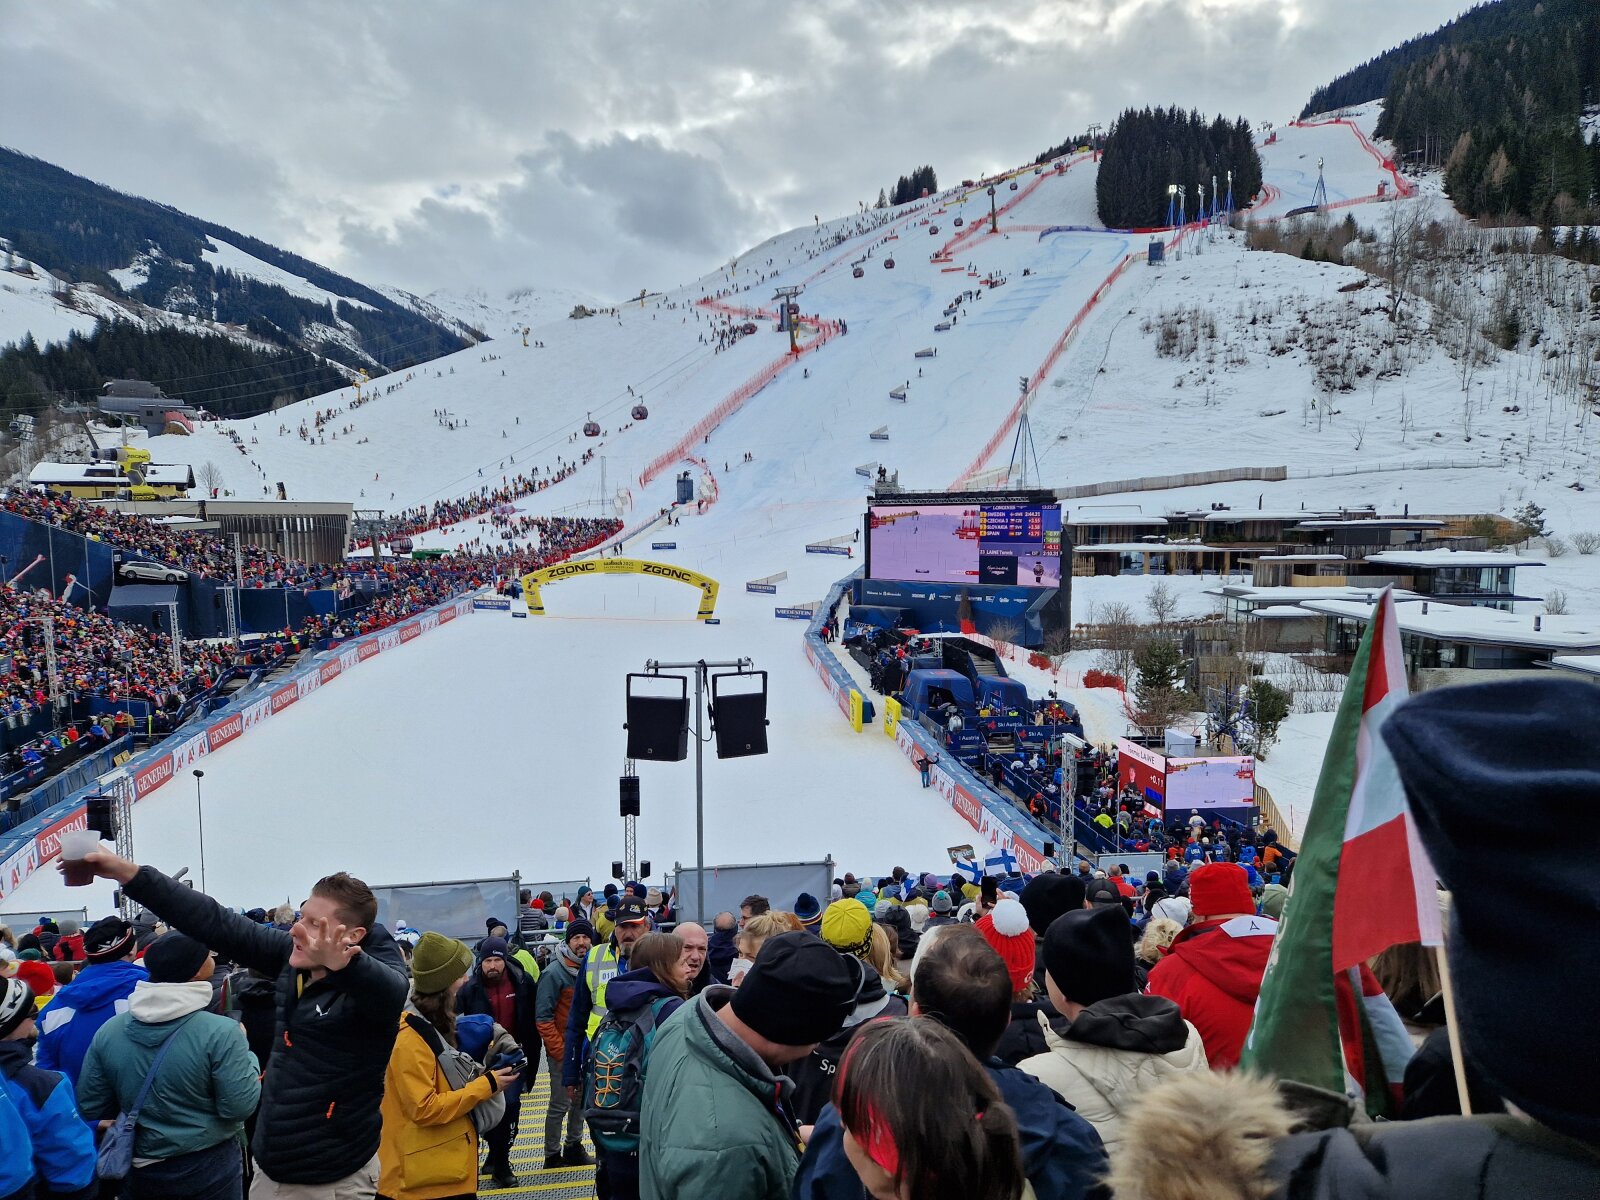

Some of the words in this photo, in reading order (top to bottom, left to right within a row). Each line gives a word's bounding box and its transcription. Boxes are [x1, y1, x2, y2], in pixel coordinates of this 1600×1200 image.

[549, 563, 596, 577] ZGONC
[643, 564, 692, 581] ZGONC
[321, 661, 341, 680] GENERALI
[272, 685, 299, 709] GENERALI
[209, 718, 242, 746] GENERALI
[176, 752, 184, 773] A1
[187, 744, 195, 765] A1
[198, 738, 206, 758] A1
[136, 758, 173, 794] GENERALI
[954, 791, 981, 825] GENERALI
[39, 811, 88, 858] GENERAL
[981, 818, 989, 834] A1
[990, 828, 999, 845] A1
[25, 850, 37, 877] A1
[1013, 843, 1041, 873] GENER
[11, 861, 21, 889] A1
[507, 1121, 516, 1146] USA
